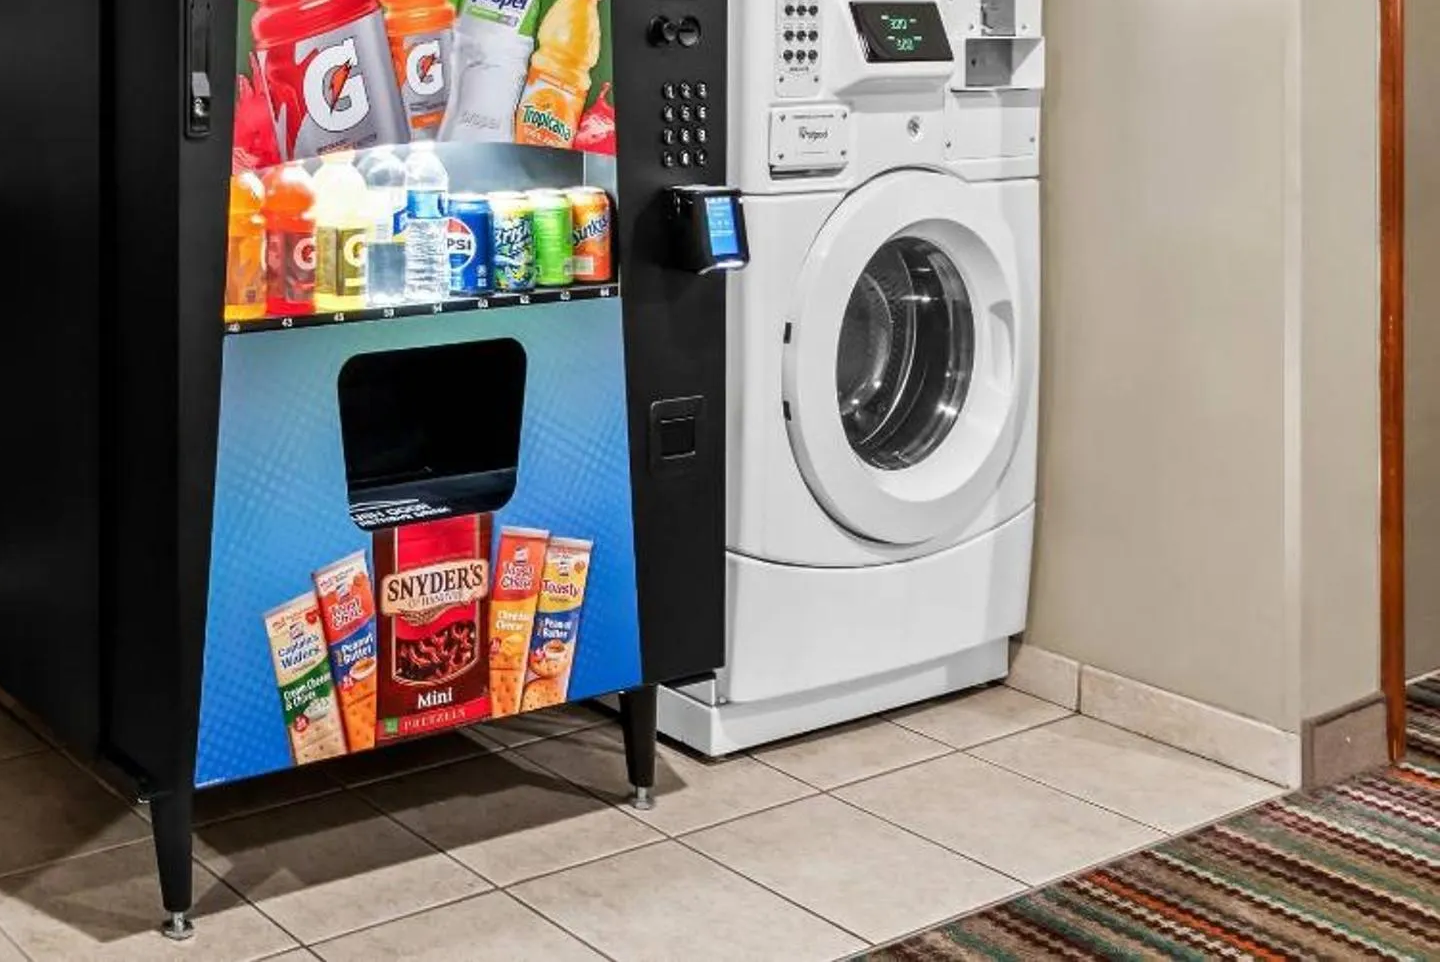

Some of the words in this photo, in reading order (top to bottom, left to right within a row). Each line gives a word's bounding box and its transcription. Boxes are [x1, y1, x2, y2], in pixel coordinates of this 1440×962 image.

[303, 36, 372, 133] G
[406, 39, 445, 96] G
[523, 104, 571, 141] Tropicana
[446, 238, 472, 251] PSI
[387, 563, 484, 602] SNYDER'S
[543, 579, 579, 598] Toasty
[417, 687, 453, 709] Mini
